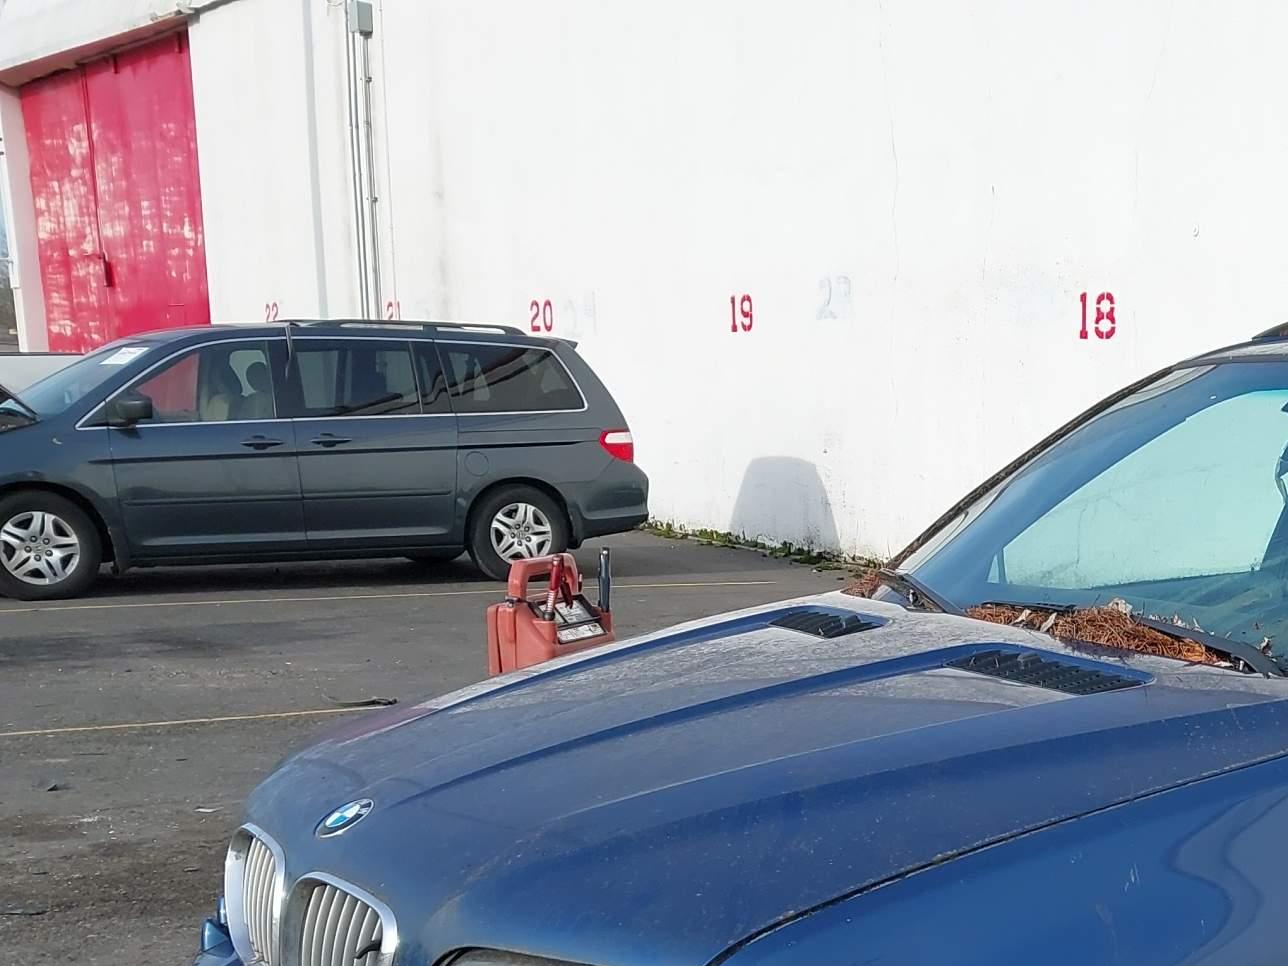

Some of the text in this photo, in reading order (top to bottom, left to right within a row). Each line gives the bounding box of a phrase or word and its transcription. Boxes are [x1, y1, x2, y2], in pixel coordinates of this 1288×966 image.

[265, 302, 279, 322] 22
[529, 299, 553, 332] 20
[730, 293, 753, 332] 19
[1079, 291, 1116, 340] 18
